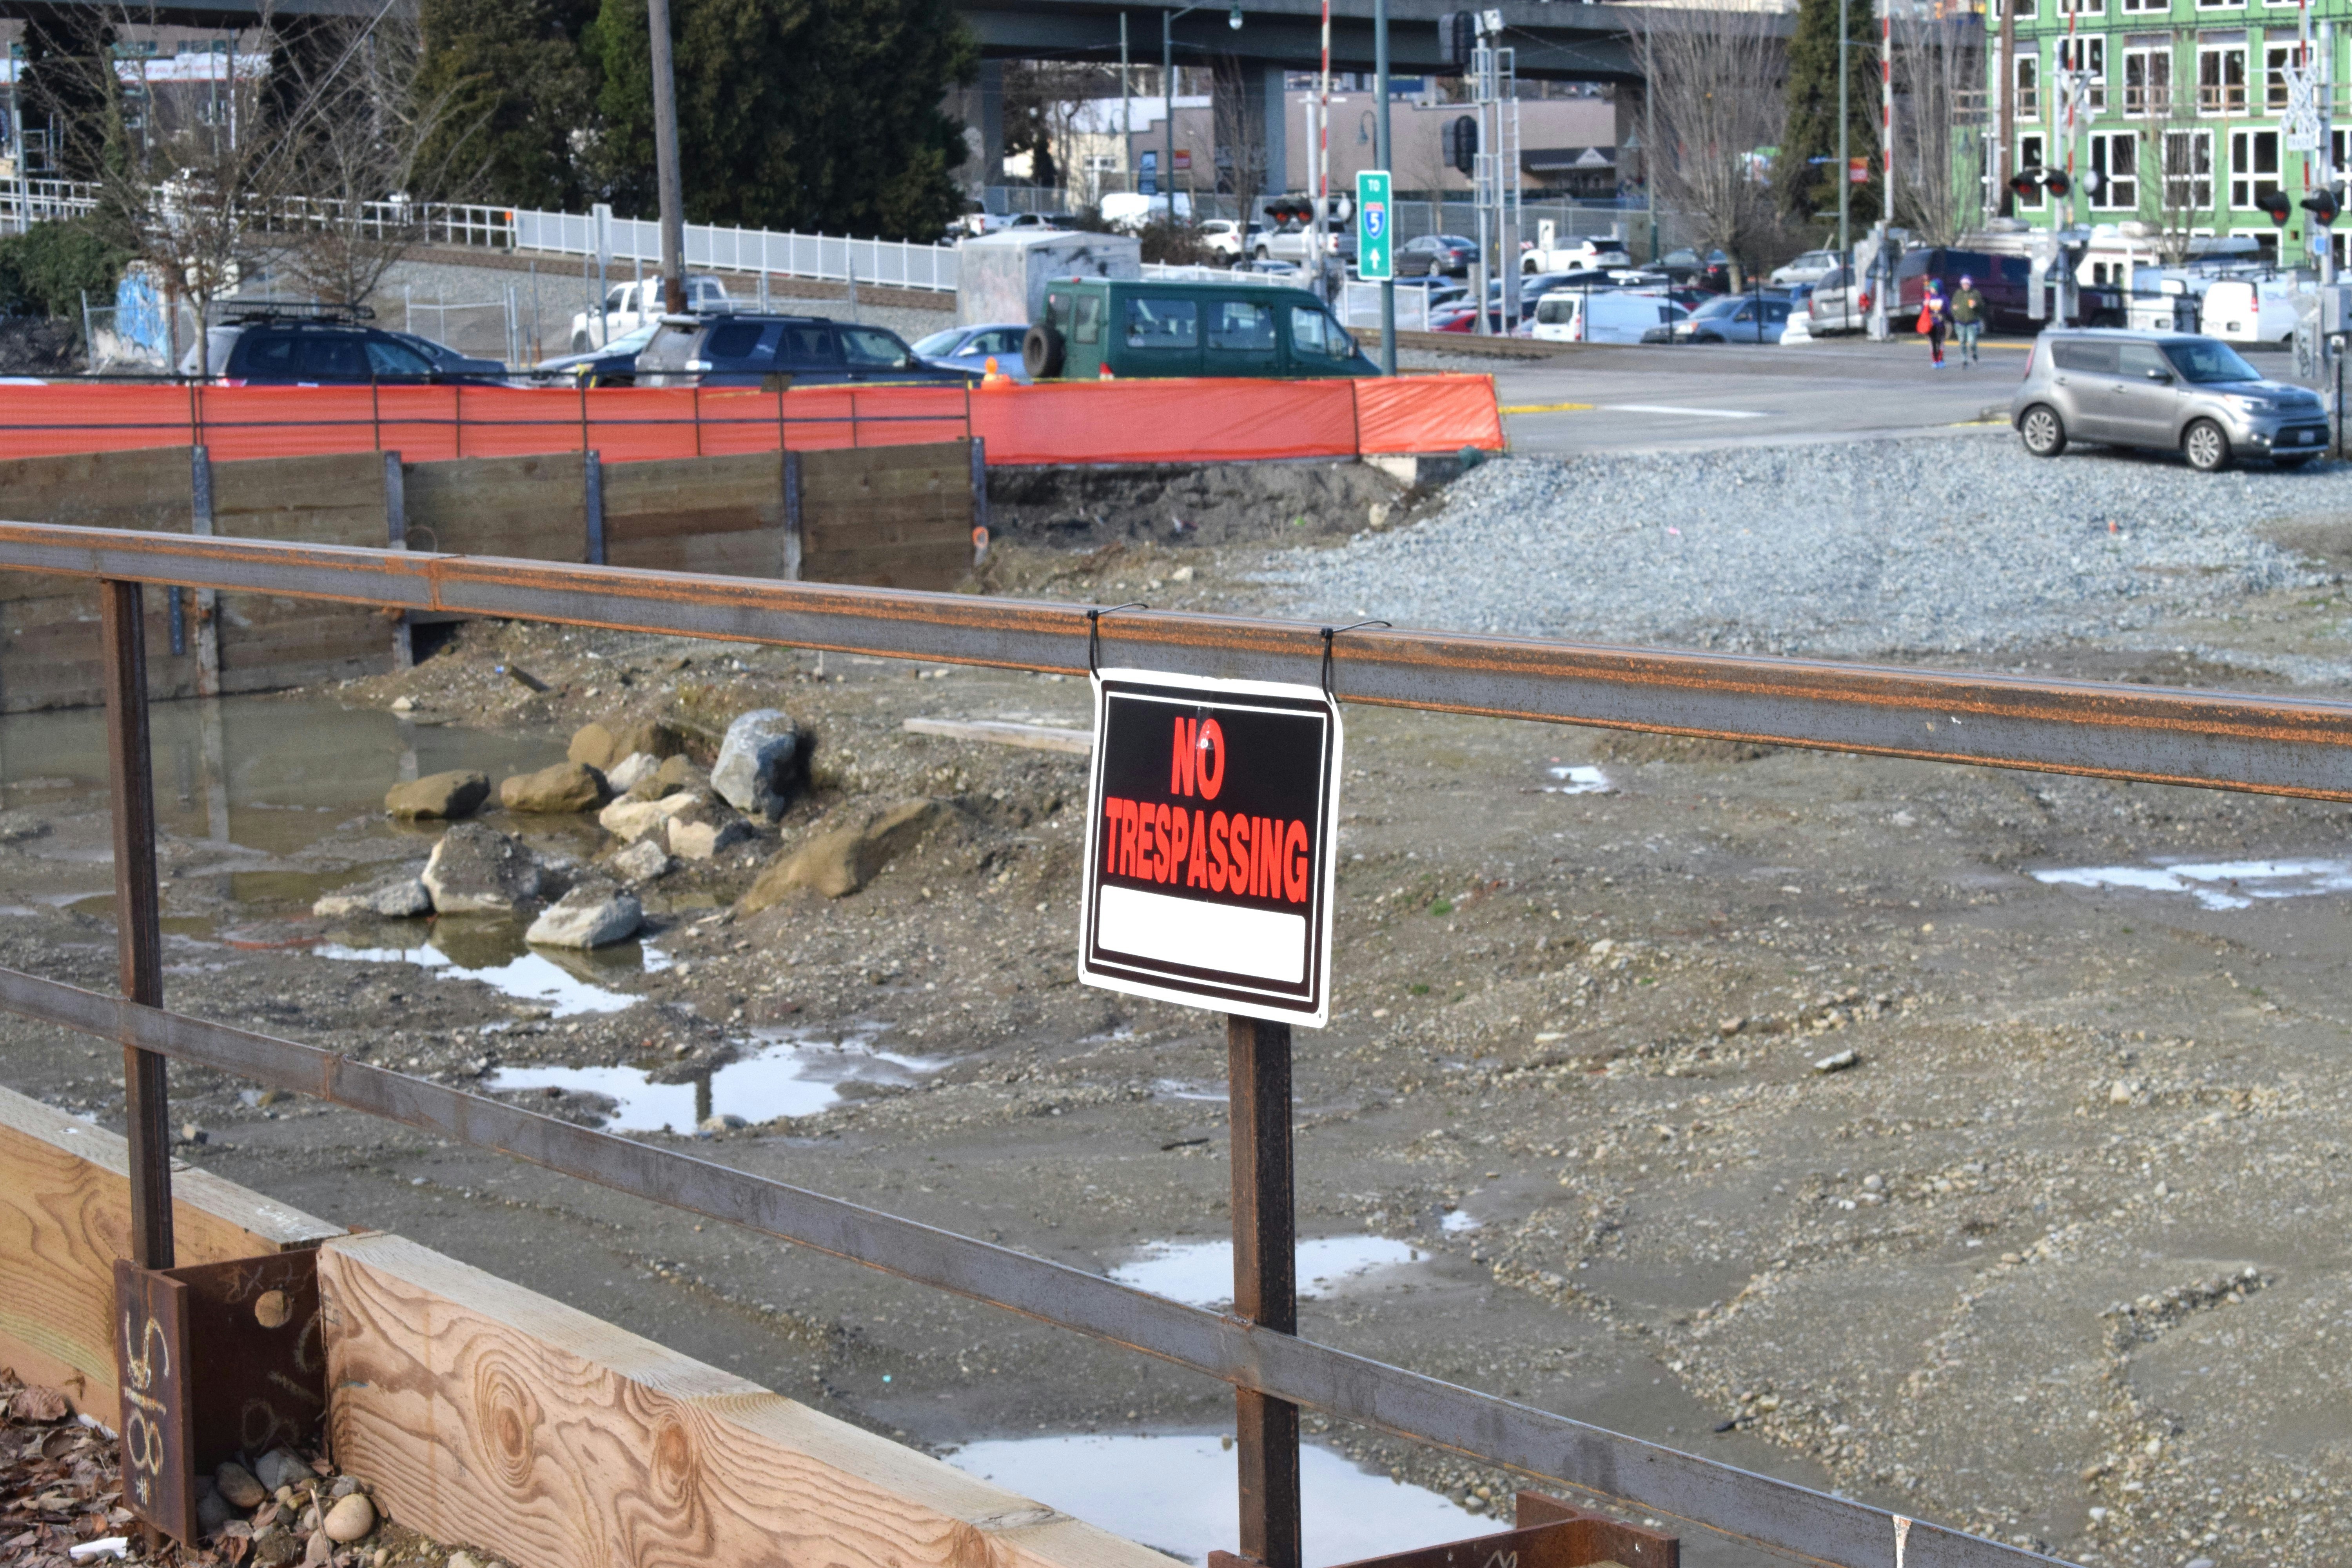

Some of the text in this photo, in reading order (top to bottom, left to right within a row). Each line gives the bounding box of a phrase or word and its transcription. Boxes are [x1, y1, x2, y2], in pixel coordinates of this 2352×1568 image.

[1367, 179, 1381, 192] TO
[1370, 212, 1380, 232] 5
[1171, 717, 1225, 800] NO
[1105, 797, 1308, 903] TRESPASSING
